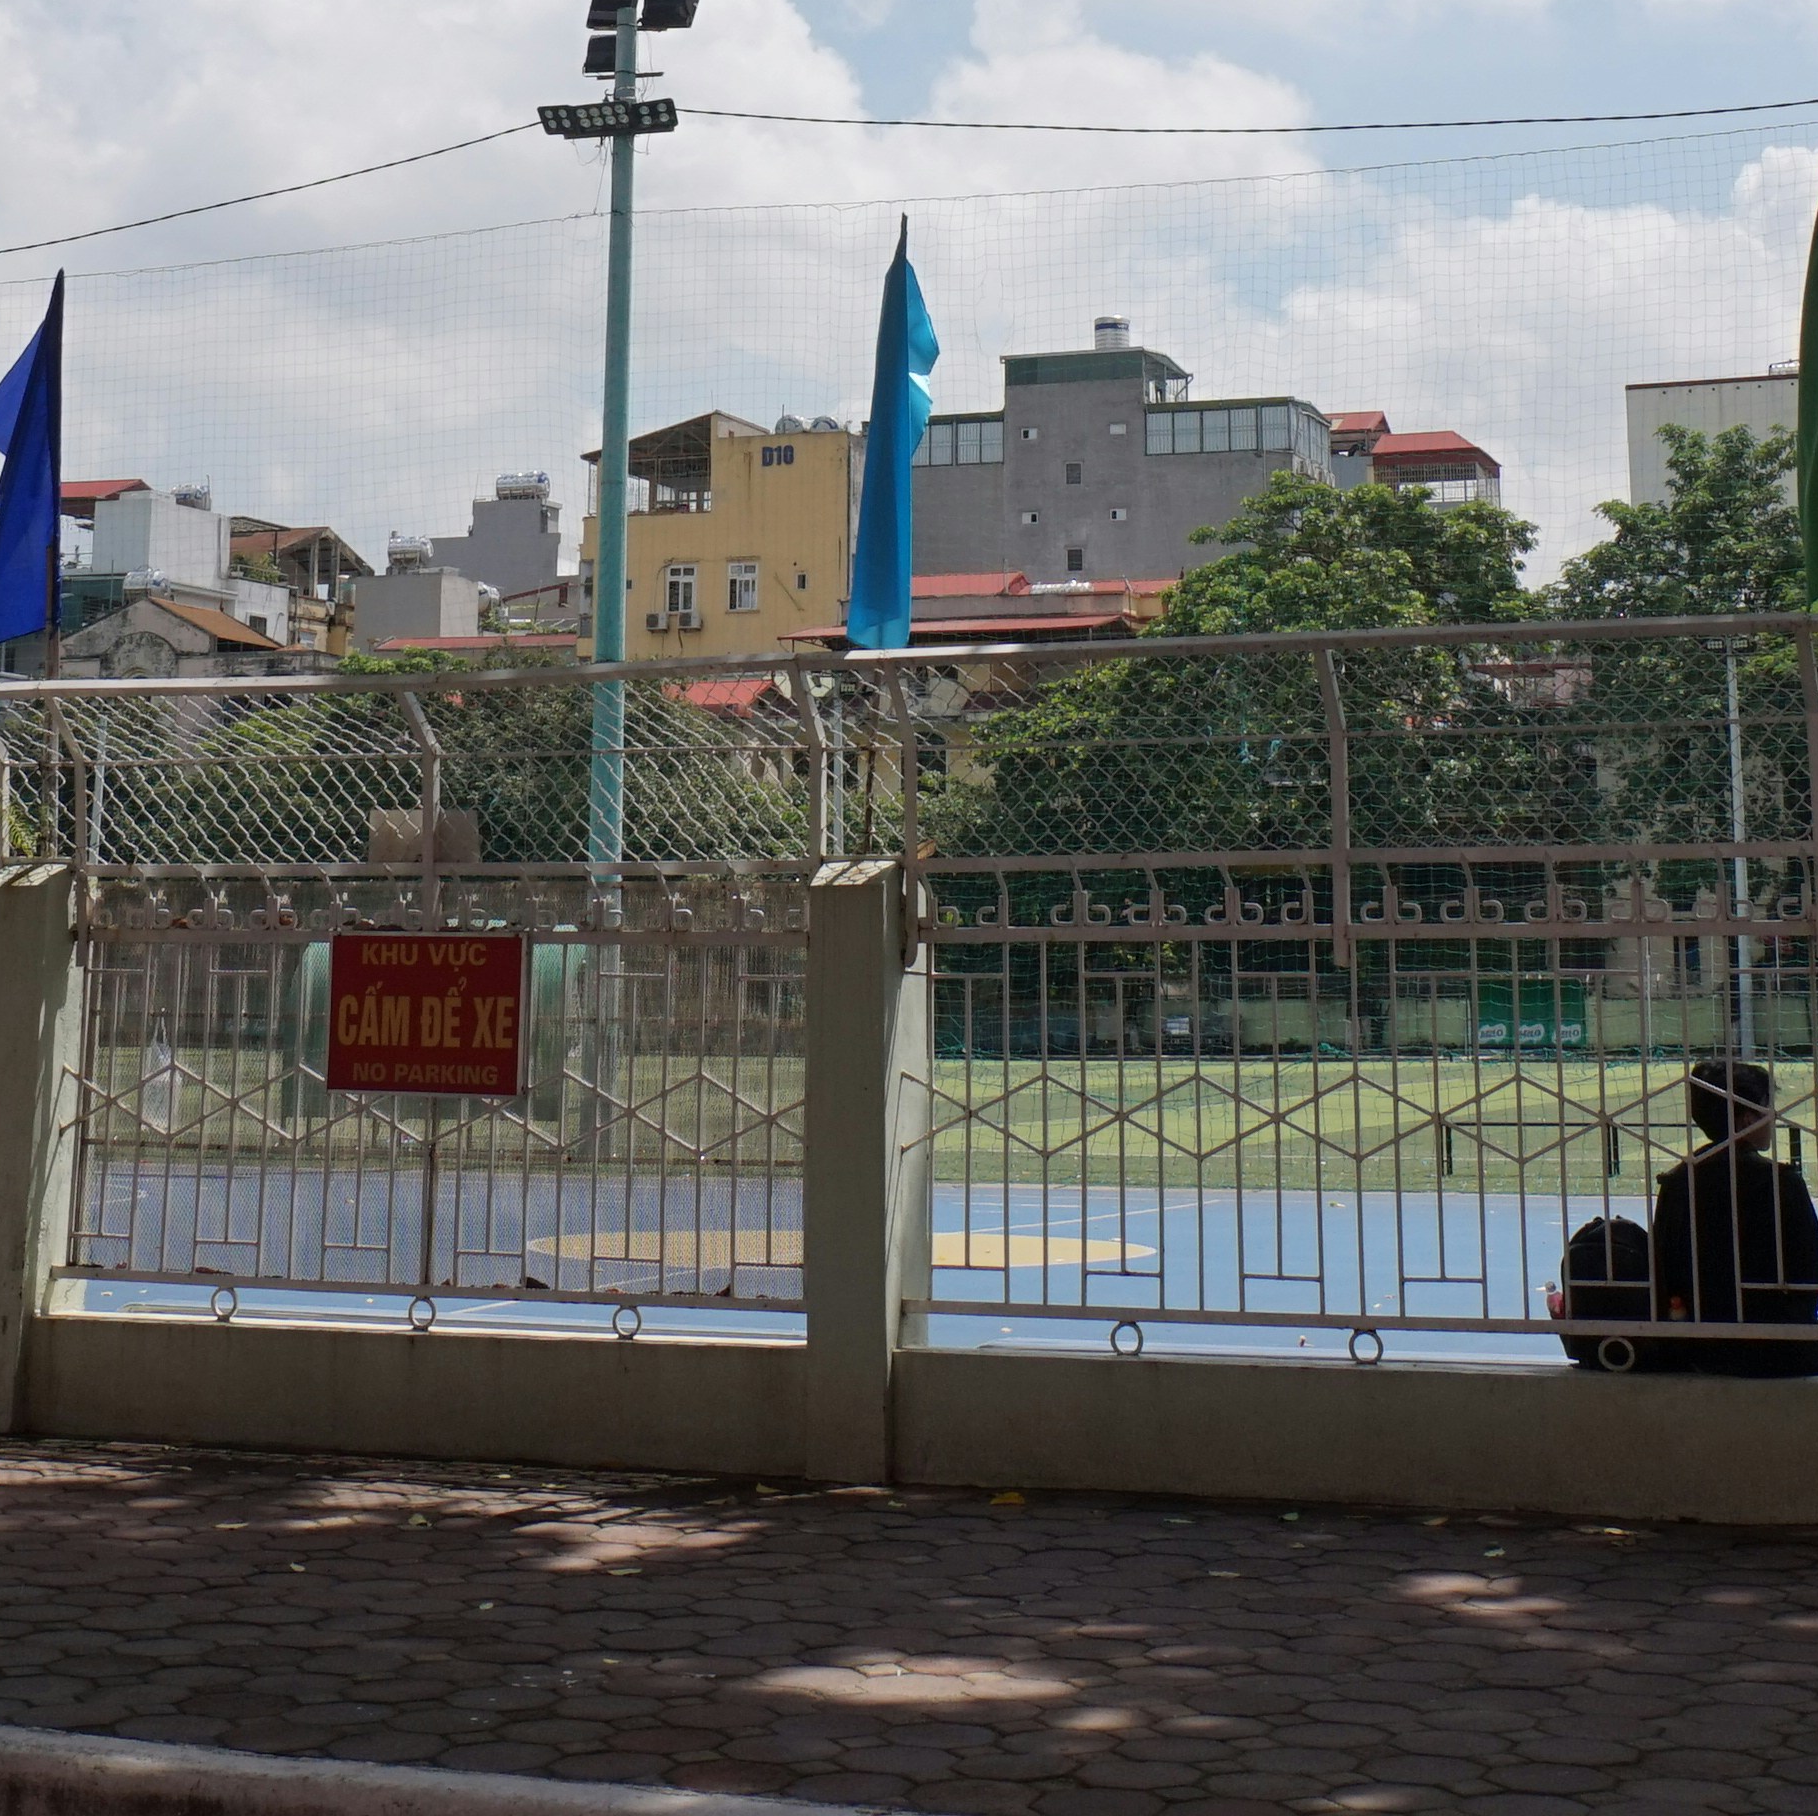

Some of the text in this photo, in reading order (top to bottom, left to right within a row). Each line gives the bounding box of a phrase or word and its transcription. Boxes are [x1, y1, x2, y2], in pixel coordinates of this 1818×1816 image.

[362, 941, 487, 972] KHU VỰC
[337, 976, 515, 1049] CẤM ĐỂ XE
[352, 1062, 499, 1085] NO PARKING
